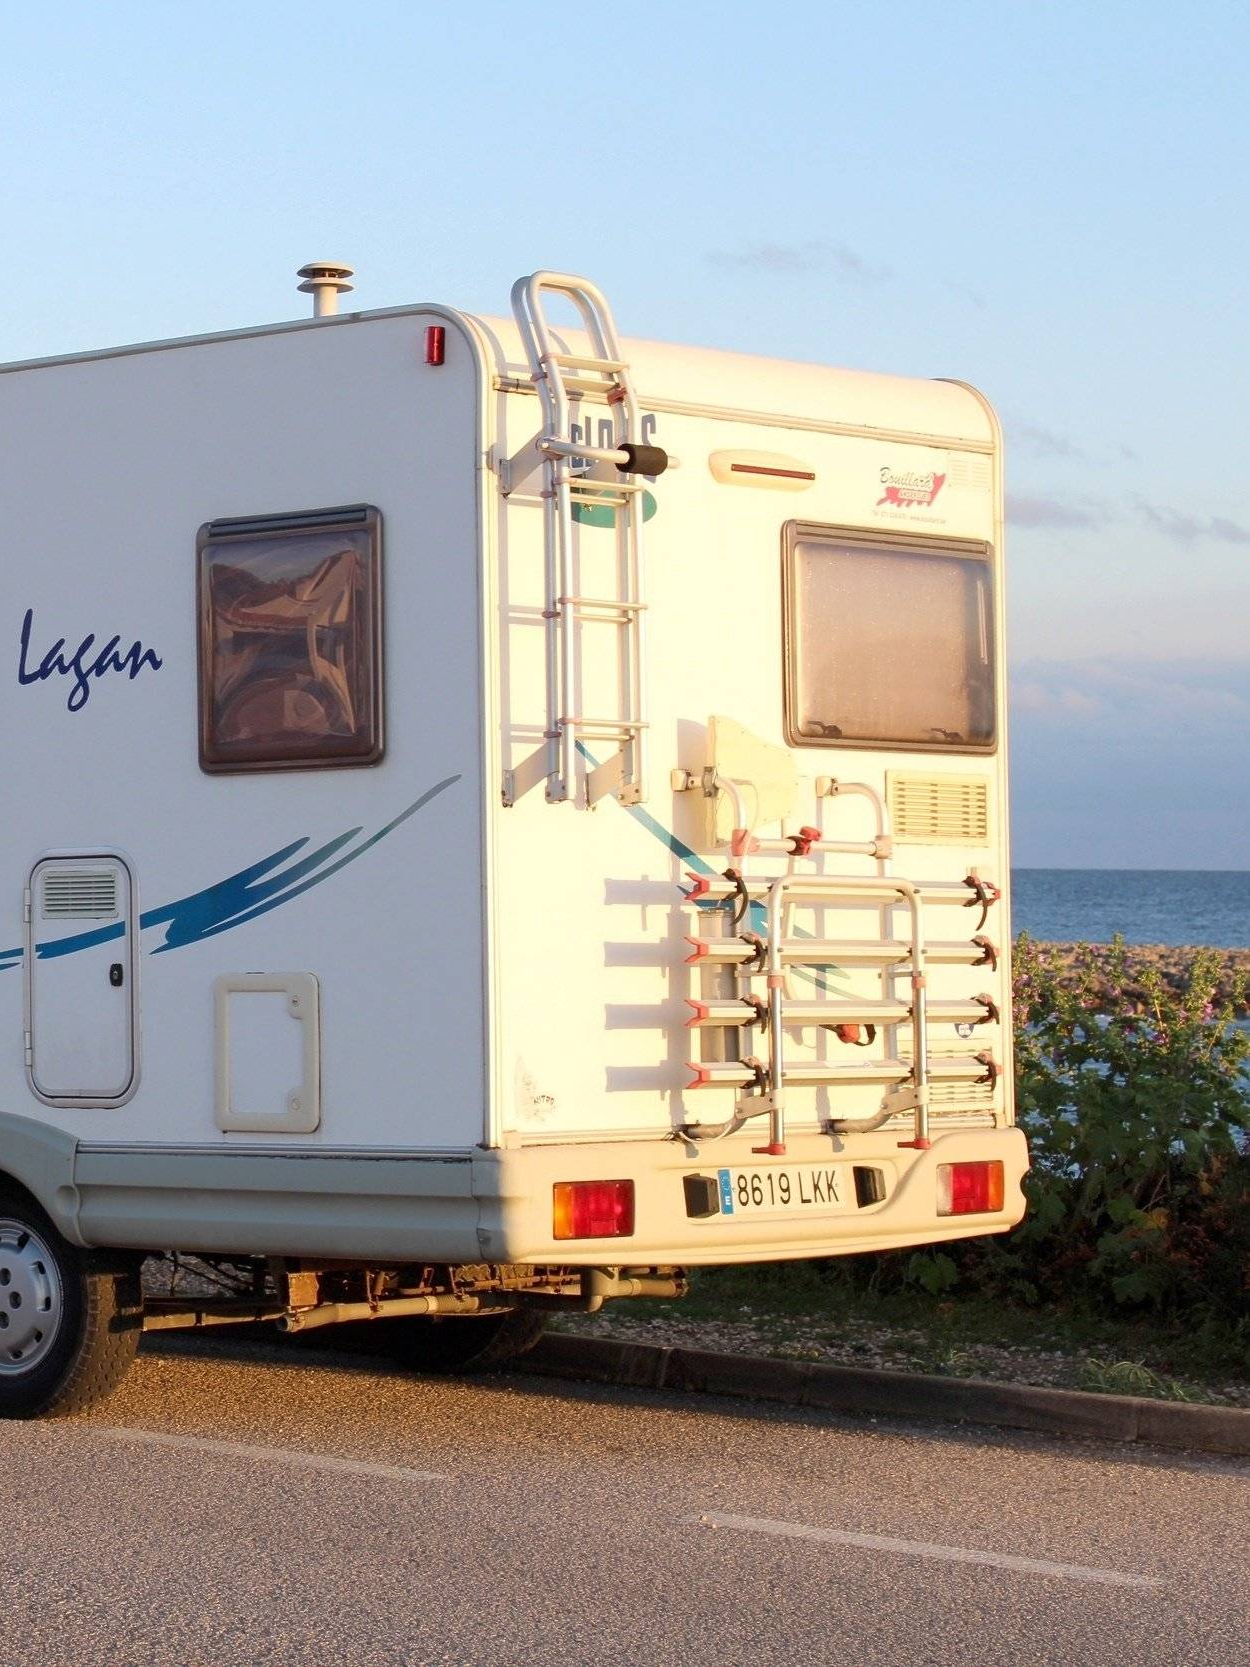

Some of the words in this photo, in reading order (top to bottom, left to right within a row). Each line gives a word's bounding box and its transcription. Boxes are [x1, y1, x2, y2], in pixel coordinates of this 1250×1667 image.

[18, 608, 163, 712] Lagan
[737, 1172, 791, 1207] 8619
[797, 1169, 840, 1204] LKK
